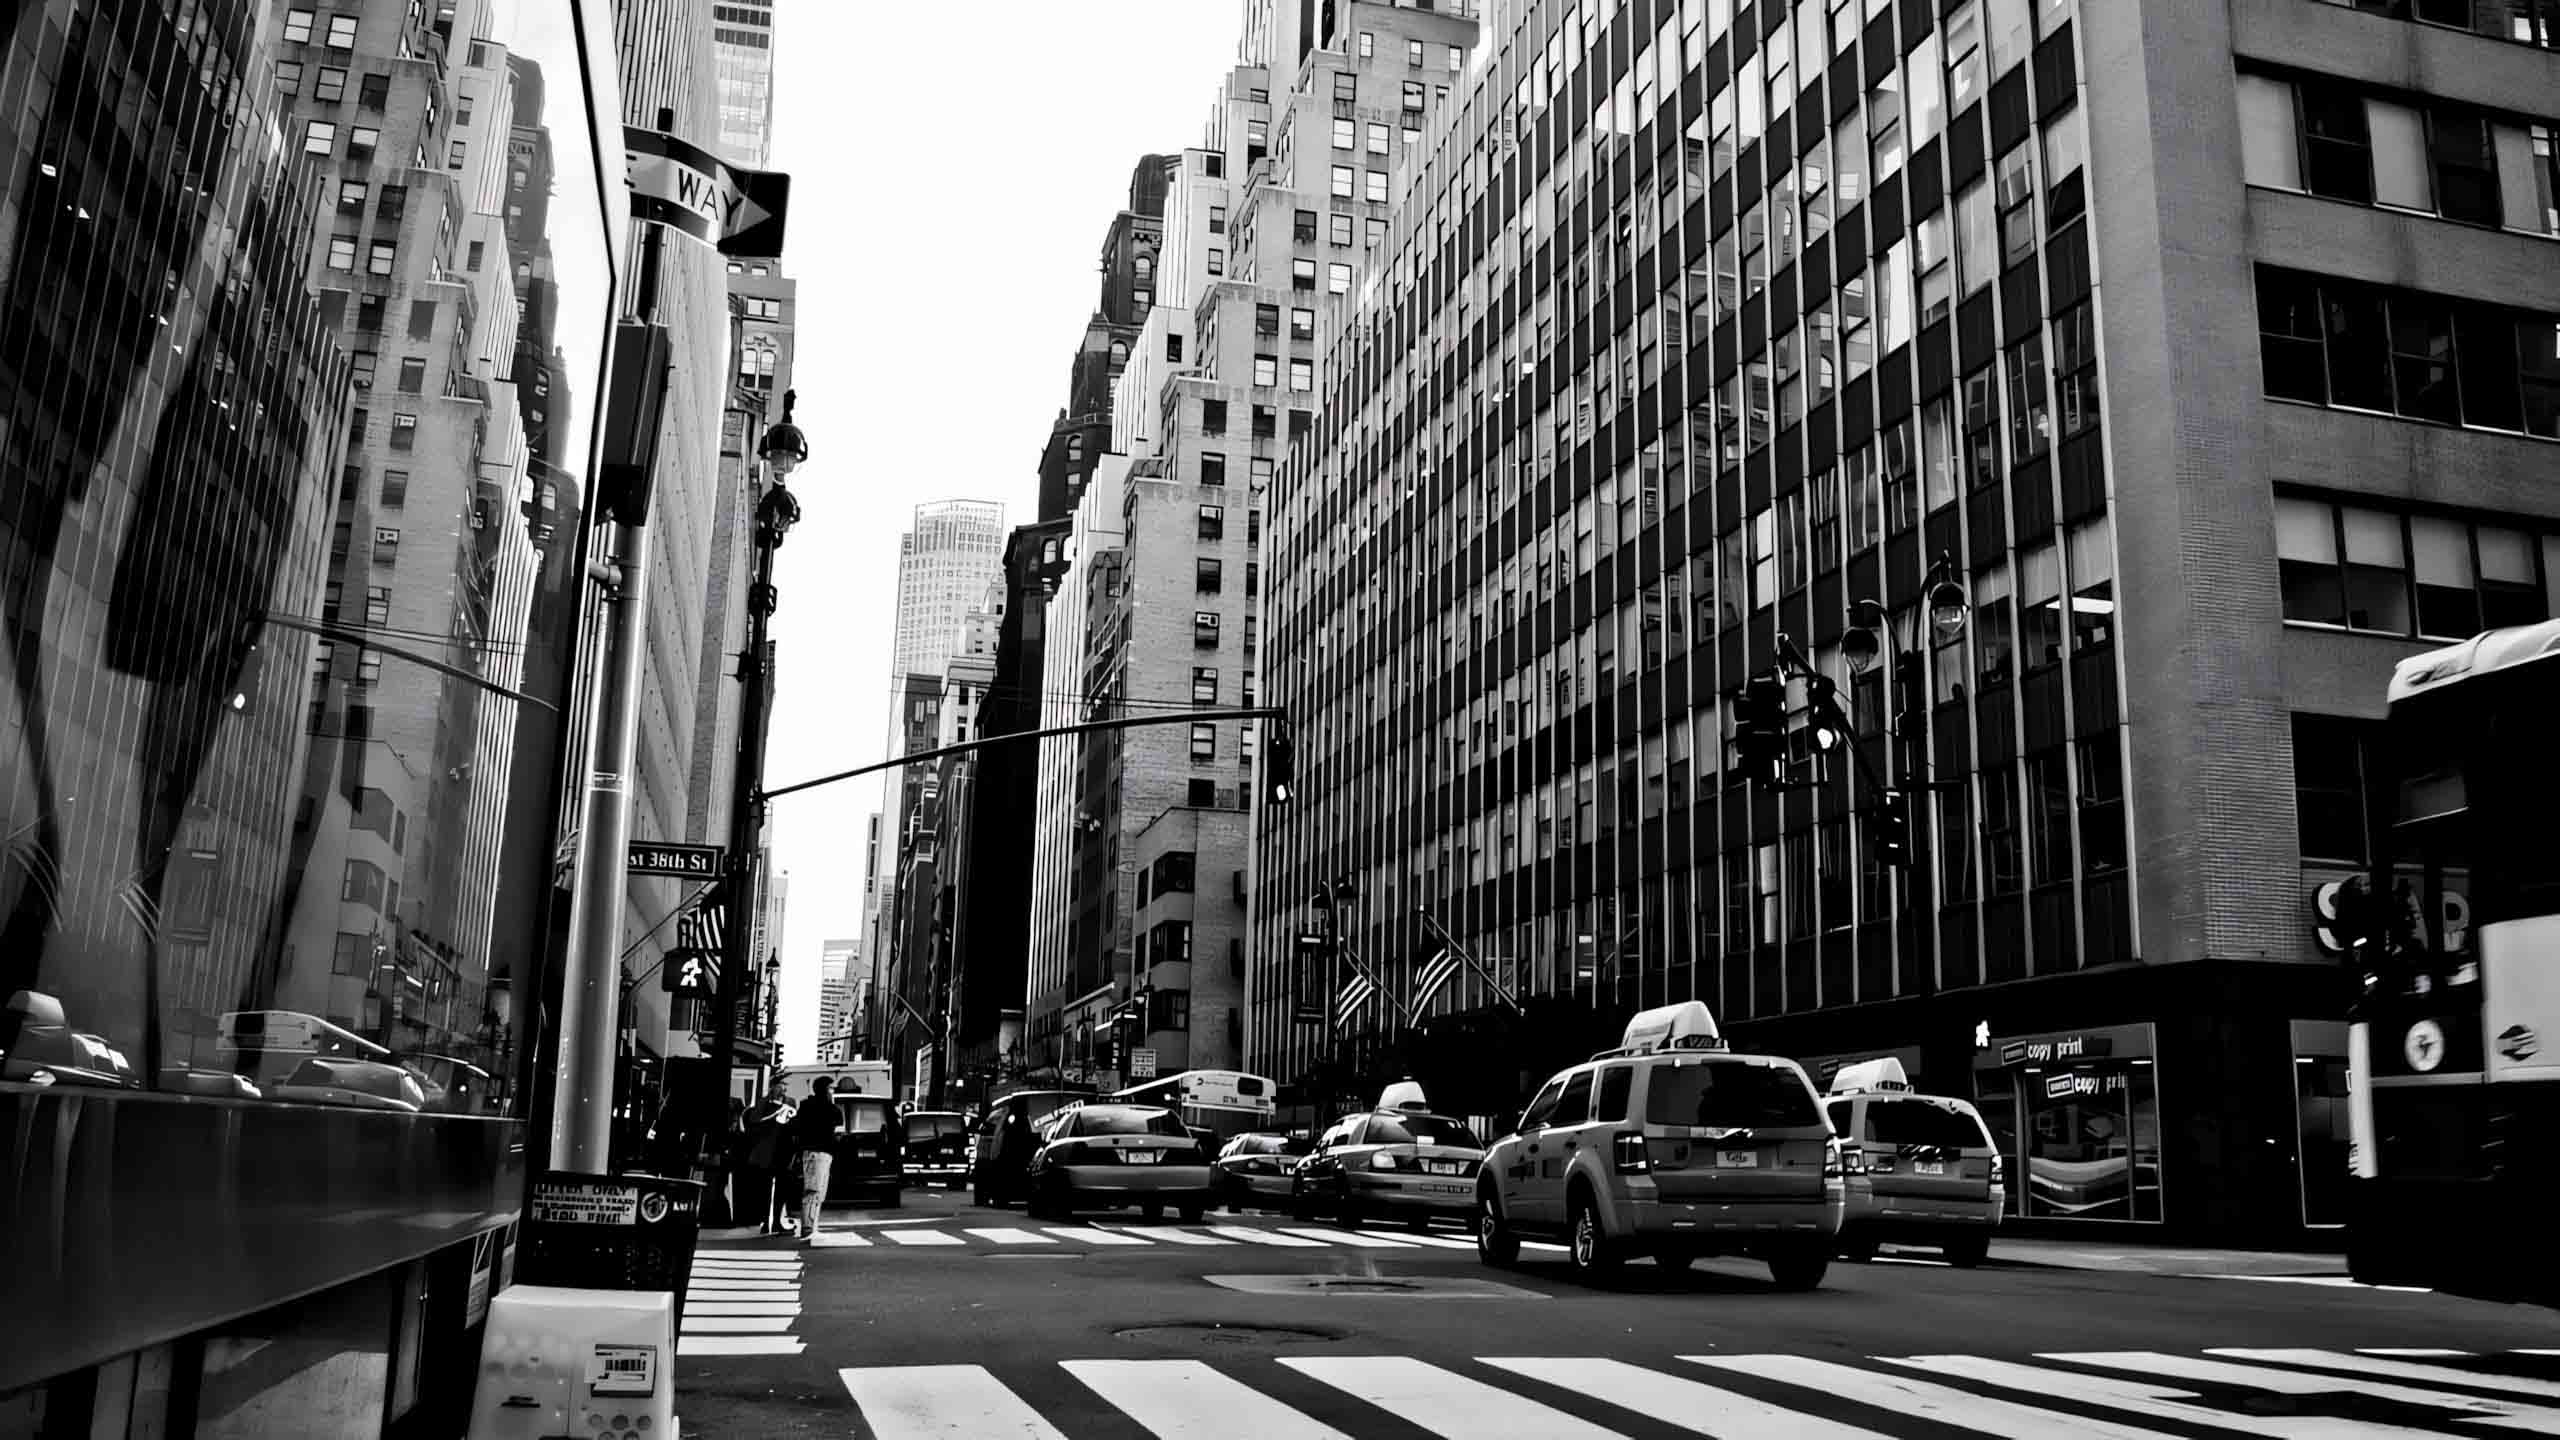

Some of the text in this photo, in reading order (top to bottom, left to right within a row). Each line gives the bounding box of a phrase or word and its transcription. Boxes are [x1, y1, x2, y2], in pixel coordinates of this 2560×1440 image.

[678, 168, 744, 227] WAY
[648, 852, 685, 869] 38th
[690, 854, 707, 870] St
[2027, 1043, 2052, 1061] copy
[2057, 1036, 2083, 1060] print
[2075, 1076, 2100, 1094] copy
